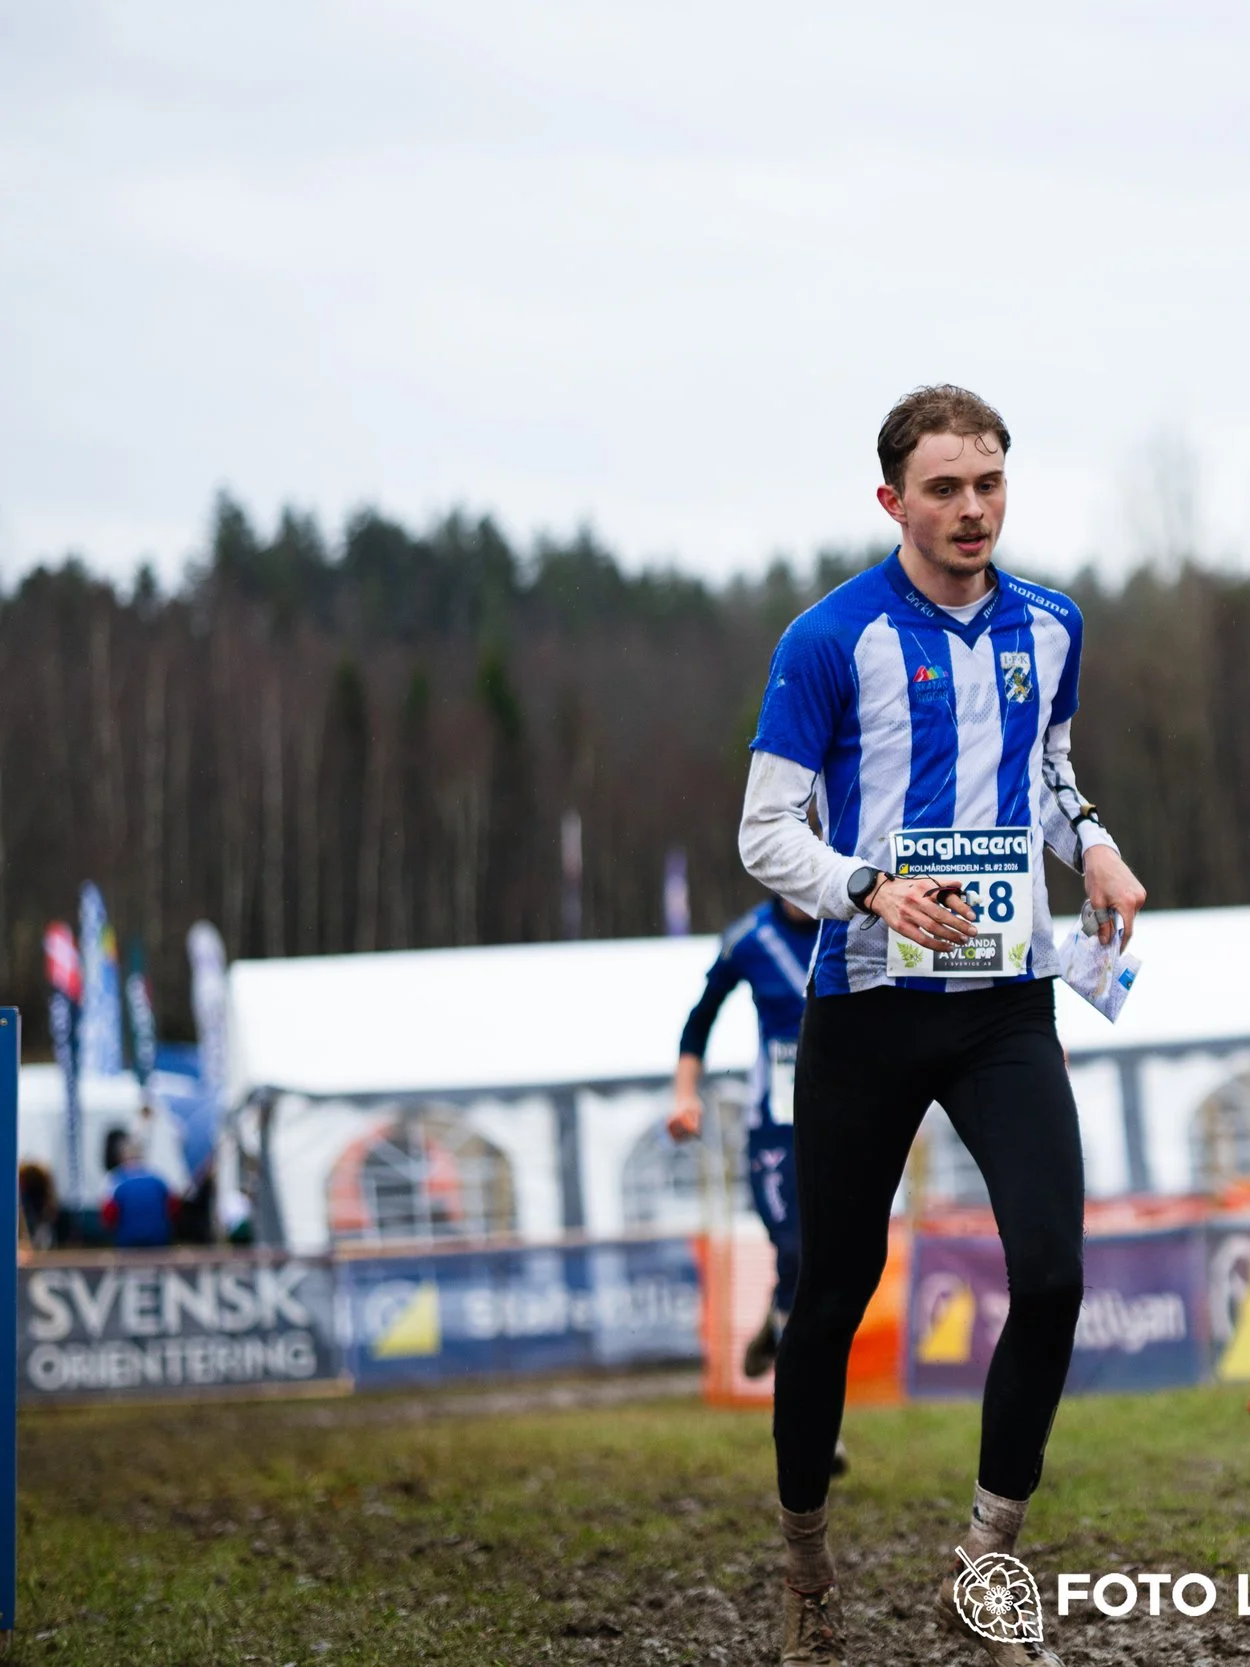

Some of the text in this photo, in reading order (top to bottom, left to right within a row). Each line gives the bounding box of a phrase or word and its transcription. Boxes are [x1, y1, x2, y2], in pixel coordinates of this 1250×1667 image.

[1008, 581, 1069, 617] noname
[896, 833, 1027, 860] bagheera
[909, 863, 980, 873] KOLMÅRDSMEDELN
[28, 1266, 311, 1342] SVENSK
[27, 1331, 317, 1392] ORIENTERING
